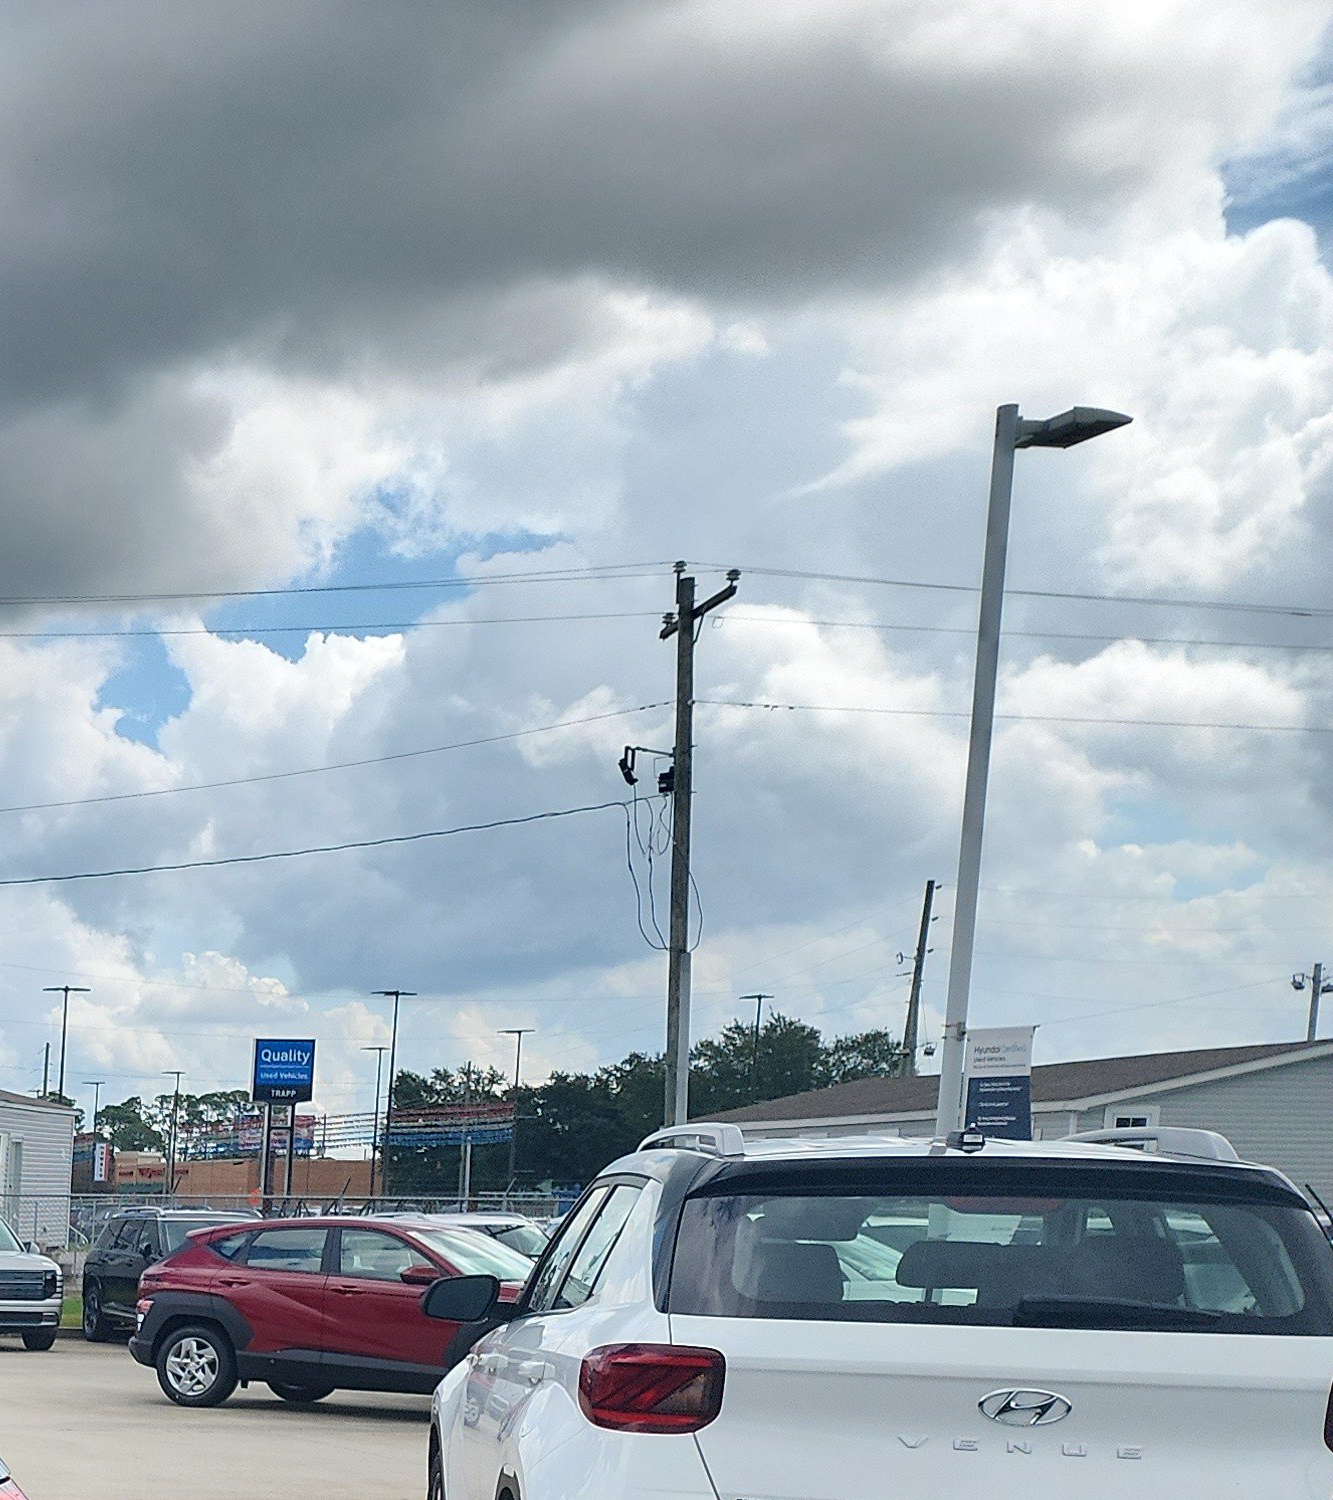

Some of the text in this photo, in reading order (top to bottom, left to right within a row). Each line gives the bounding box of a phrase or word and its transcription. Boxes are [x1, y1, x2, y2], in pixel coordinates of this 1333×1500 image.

[261, 1048, 310, 1066] Quality
[271, 1089, 296, 1098] TRAPP
[897, 1434, 1143, 1460] VENUE
